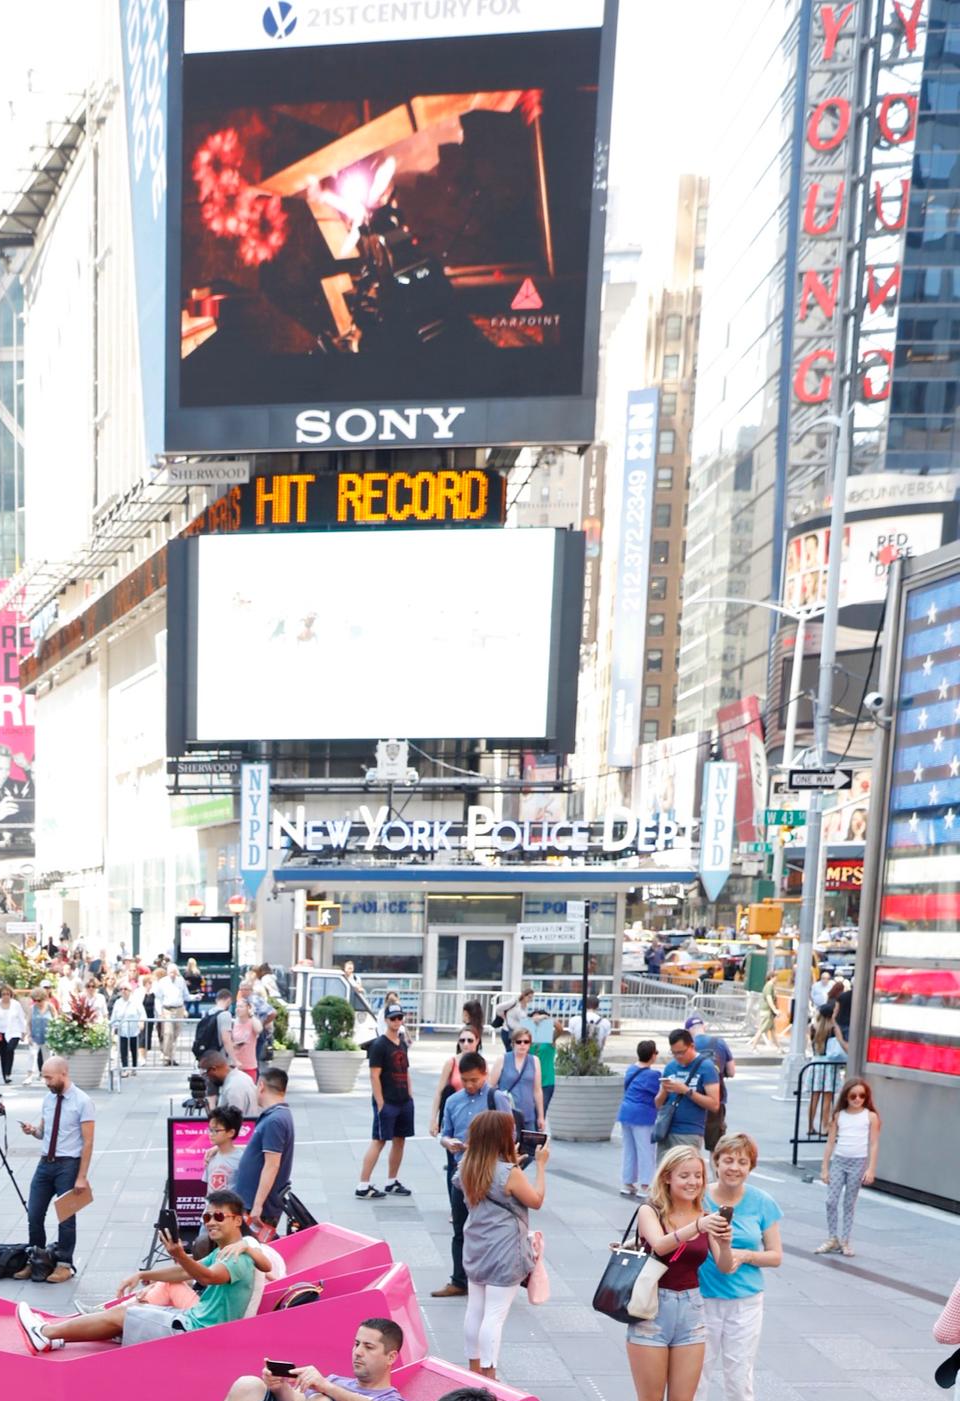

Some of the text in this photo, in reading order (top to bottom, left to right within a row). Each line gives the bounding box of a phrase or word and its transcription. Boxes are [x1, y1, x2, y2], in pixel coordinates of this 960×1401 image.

[307, 0, 520, 27] 21ST CENTURY FOX
[296, 407, 465, 443] SONY
[169, 467, 247, 481] SHERWOOD
[256, 474, 316, 526] HIT
[337, 469, 489, 524] RECORD
[177, 763, 237, 773] SHERWOOD
[795, 775, 834, 784] ONE WAY
[248, 769, 262, 866] NYPD
[359, 805, 453, 851] YORK
[467, 805, 589, 852] POLICE
[712, 768, 731, 866] NYPD
[781, 811, 794, 825] 43
